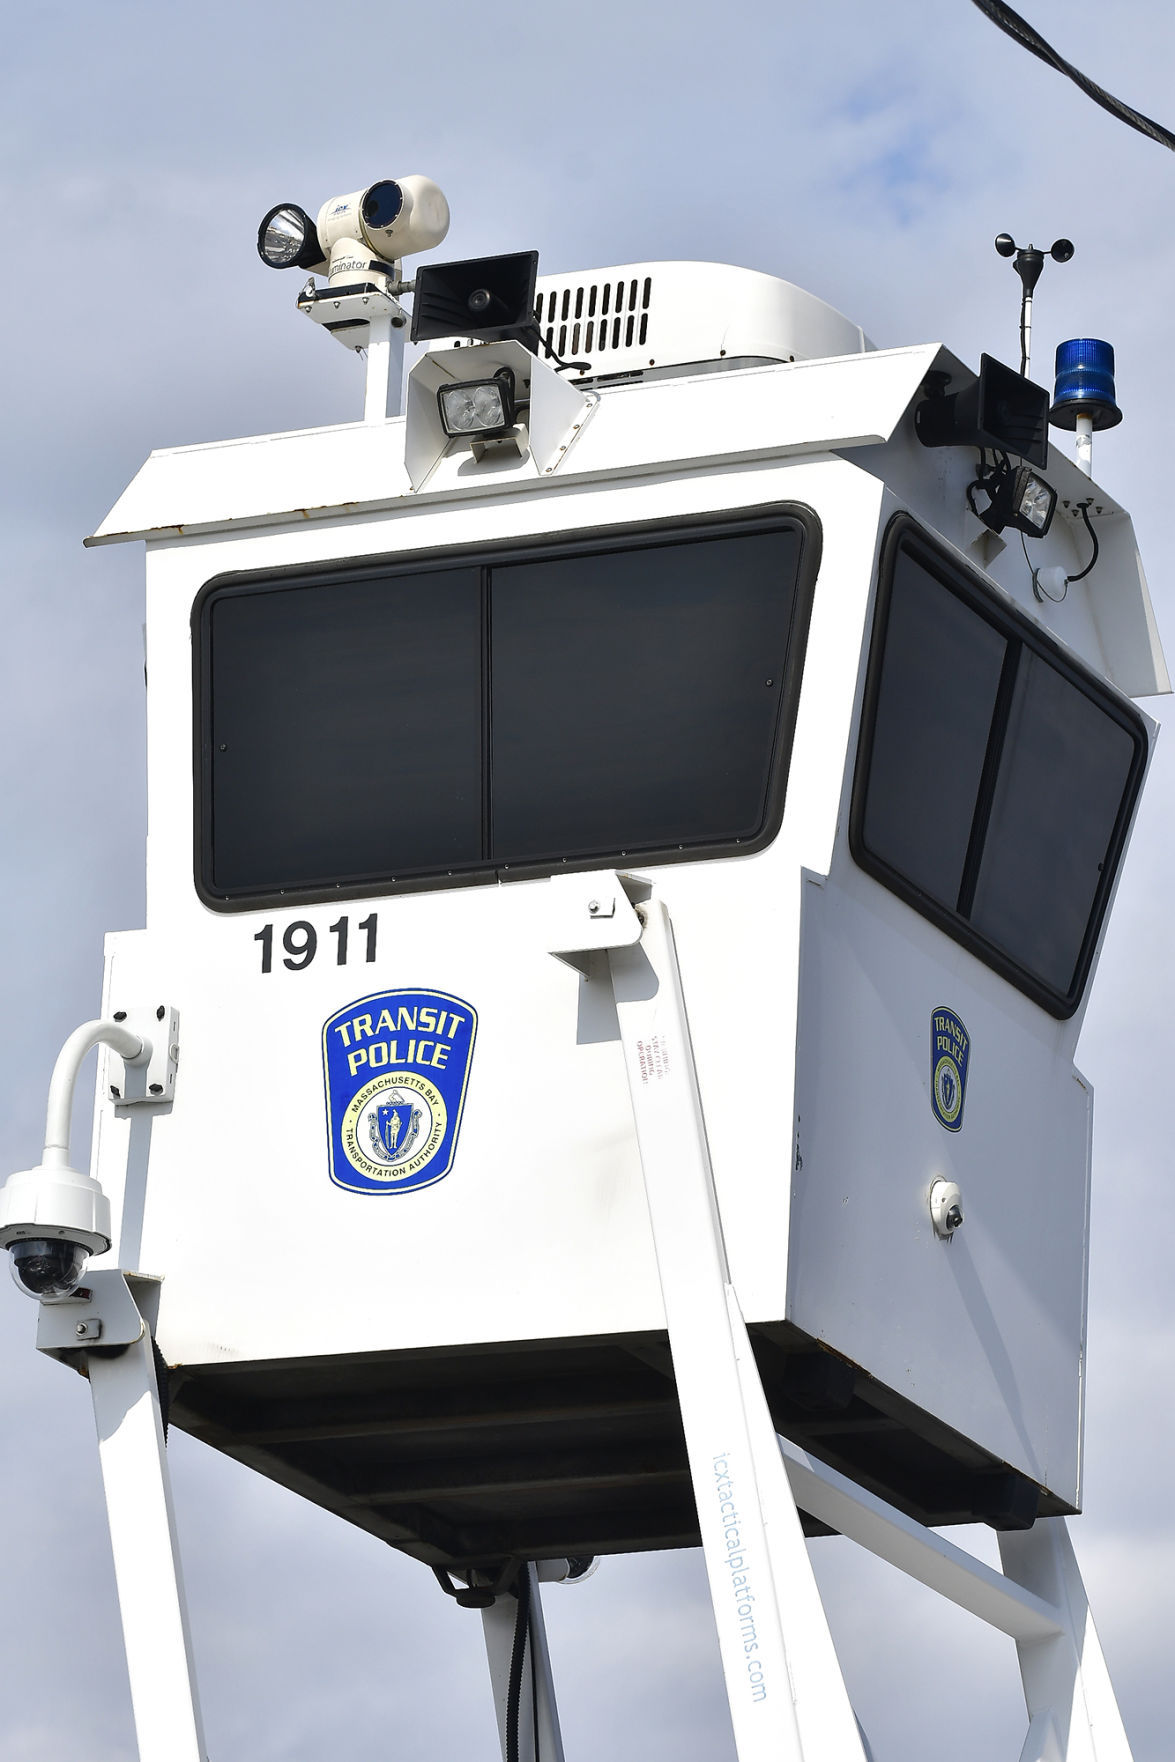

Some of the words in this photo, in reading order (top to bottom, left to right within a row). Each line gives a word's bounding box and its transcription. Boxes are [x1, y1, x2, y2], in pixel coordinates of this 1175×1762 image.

[254, 913, 378, 973] 1911
[334, 1006, 465, 1048] TRANSIT
[934, 1016, 967, 1052] TRANSIT
[347, 1039, 451, 1077] POLICE
[937, 1036, 964, 1067] POLICE
[351, 1076, 426, 1113] MASSACHUSETTS
[424, 1088, 439, 1106] BAY
[346, 1128, 406, 1177] TRANSPORTATION
[409, 1122, 443, 1171] AUTHORITY
[713, 1452, 767, 1703] icxtacticalplatforms.com
